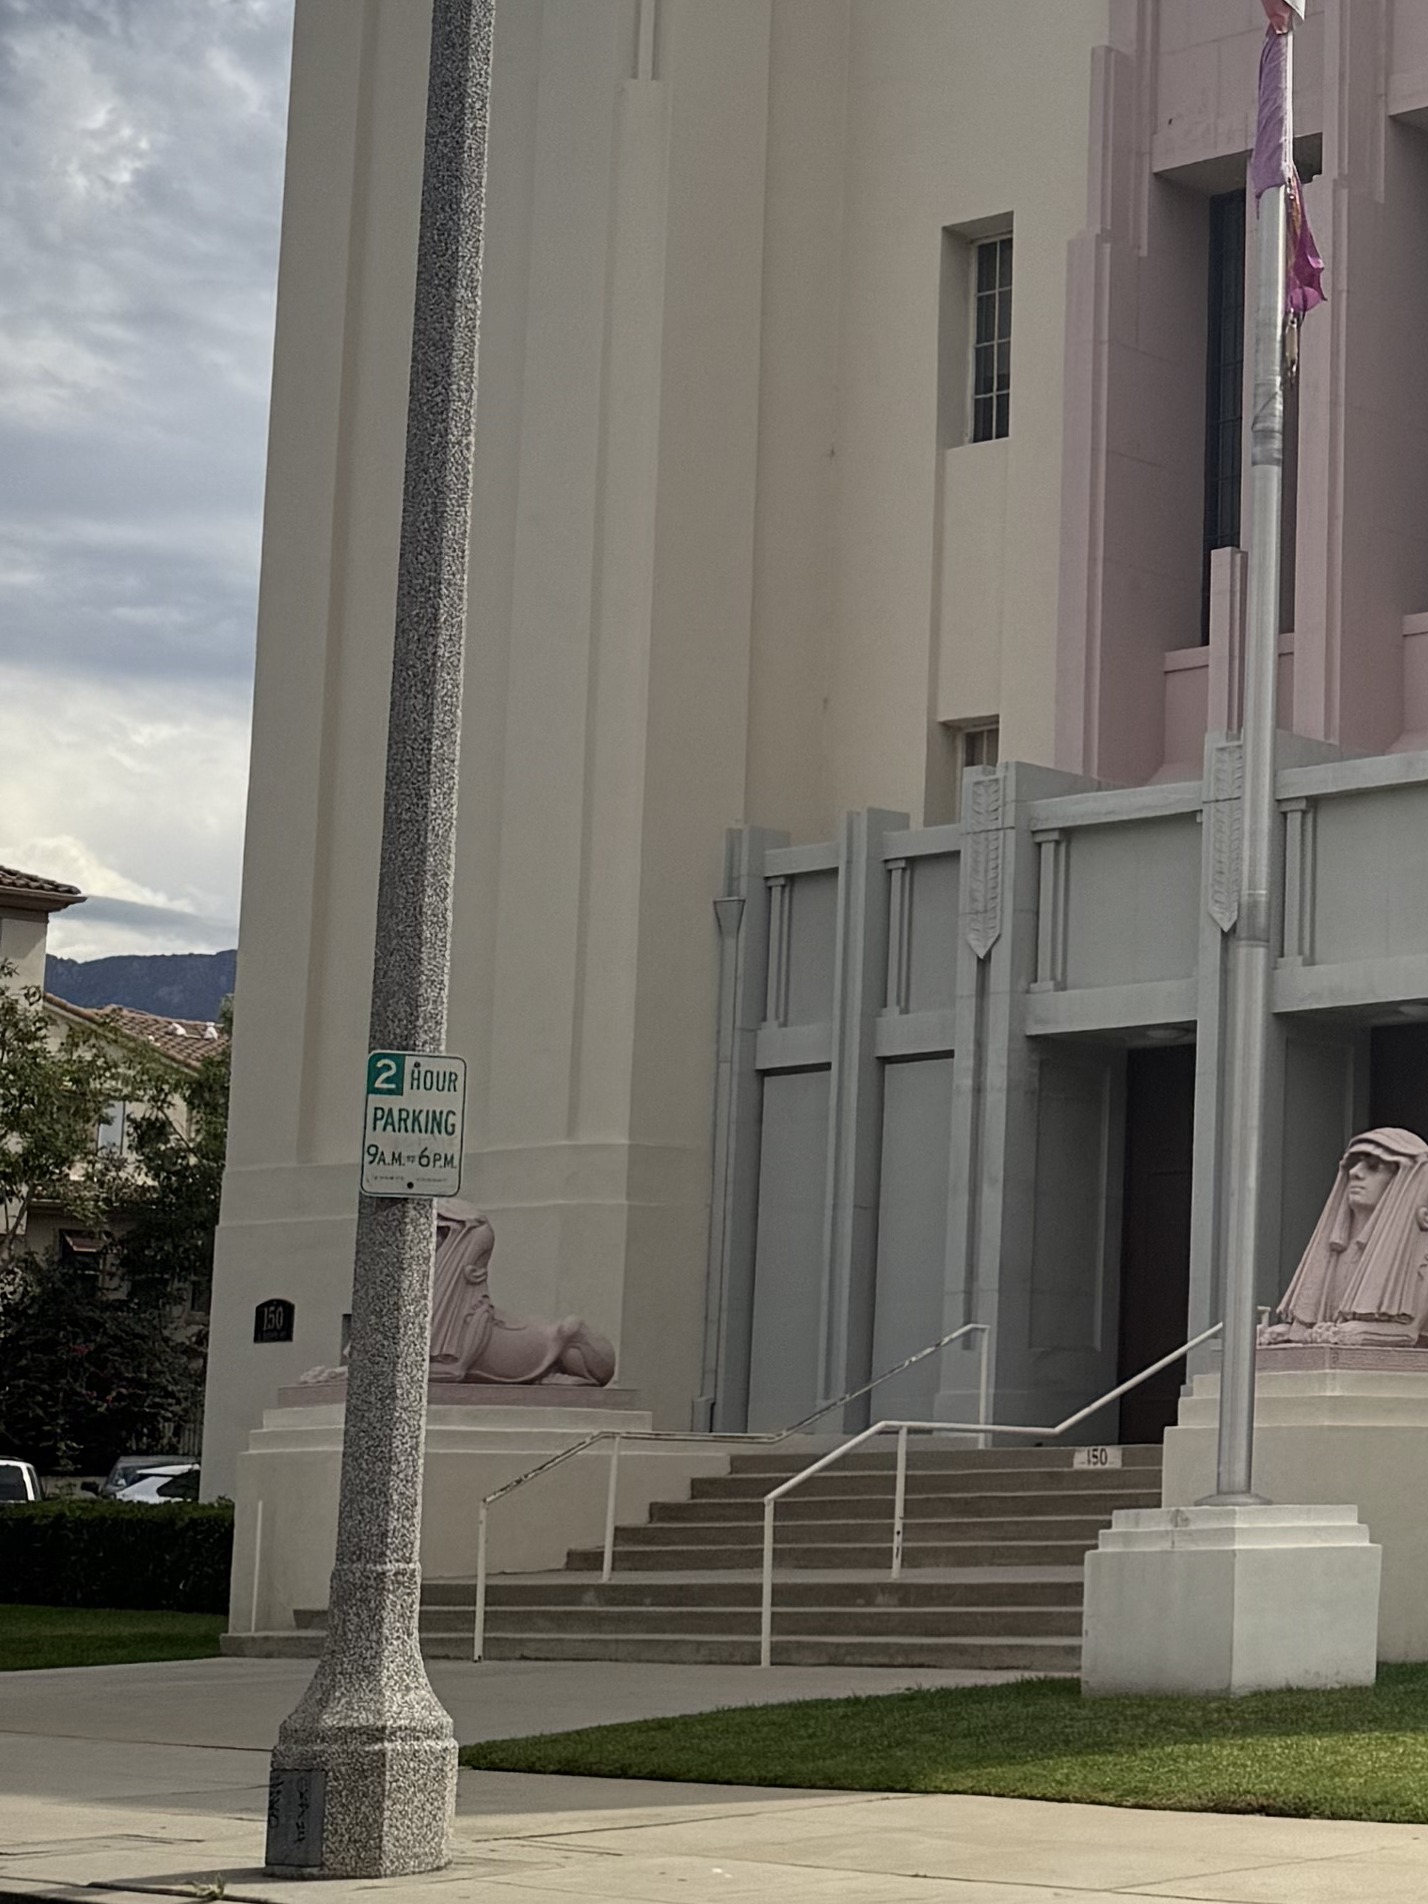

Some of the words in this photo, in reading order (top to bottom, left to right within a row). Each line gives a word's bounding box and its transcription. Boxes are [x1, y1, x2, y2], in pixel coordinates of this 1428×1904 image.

[374, 1059, 397, 1089] 2
[410, 1069, 458, 1092] HOUR
[372, 1107, 457, 1136] PARKING
[263, 1306, 283, 1331] 150
[1087, 1447, 1108, 1466] 150
